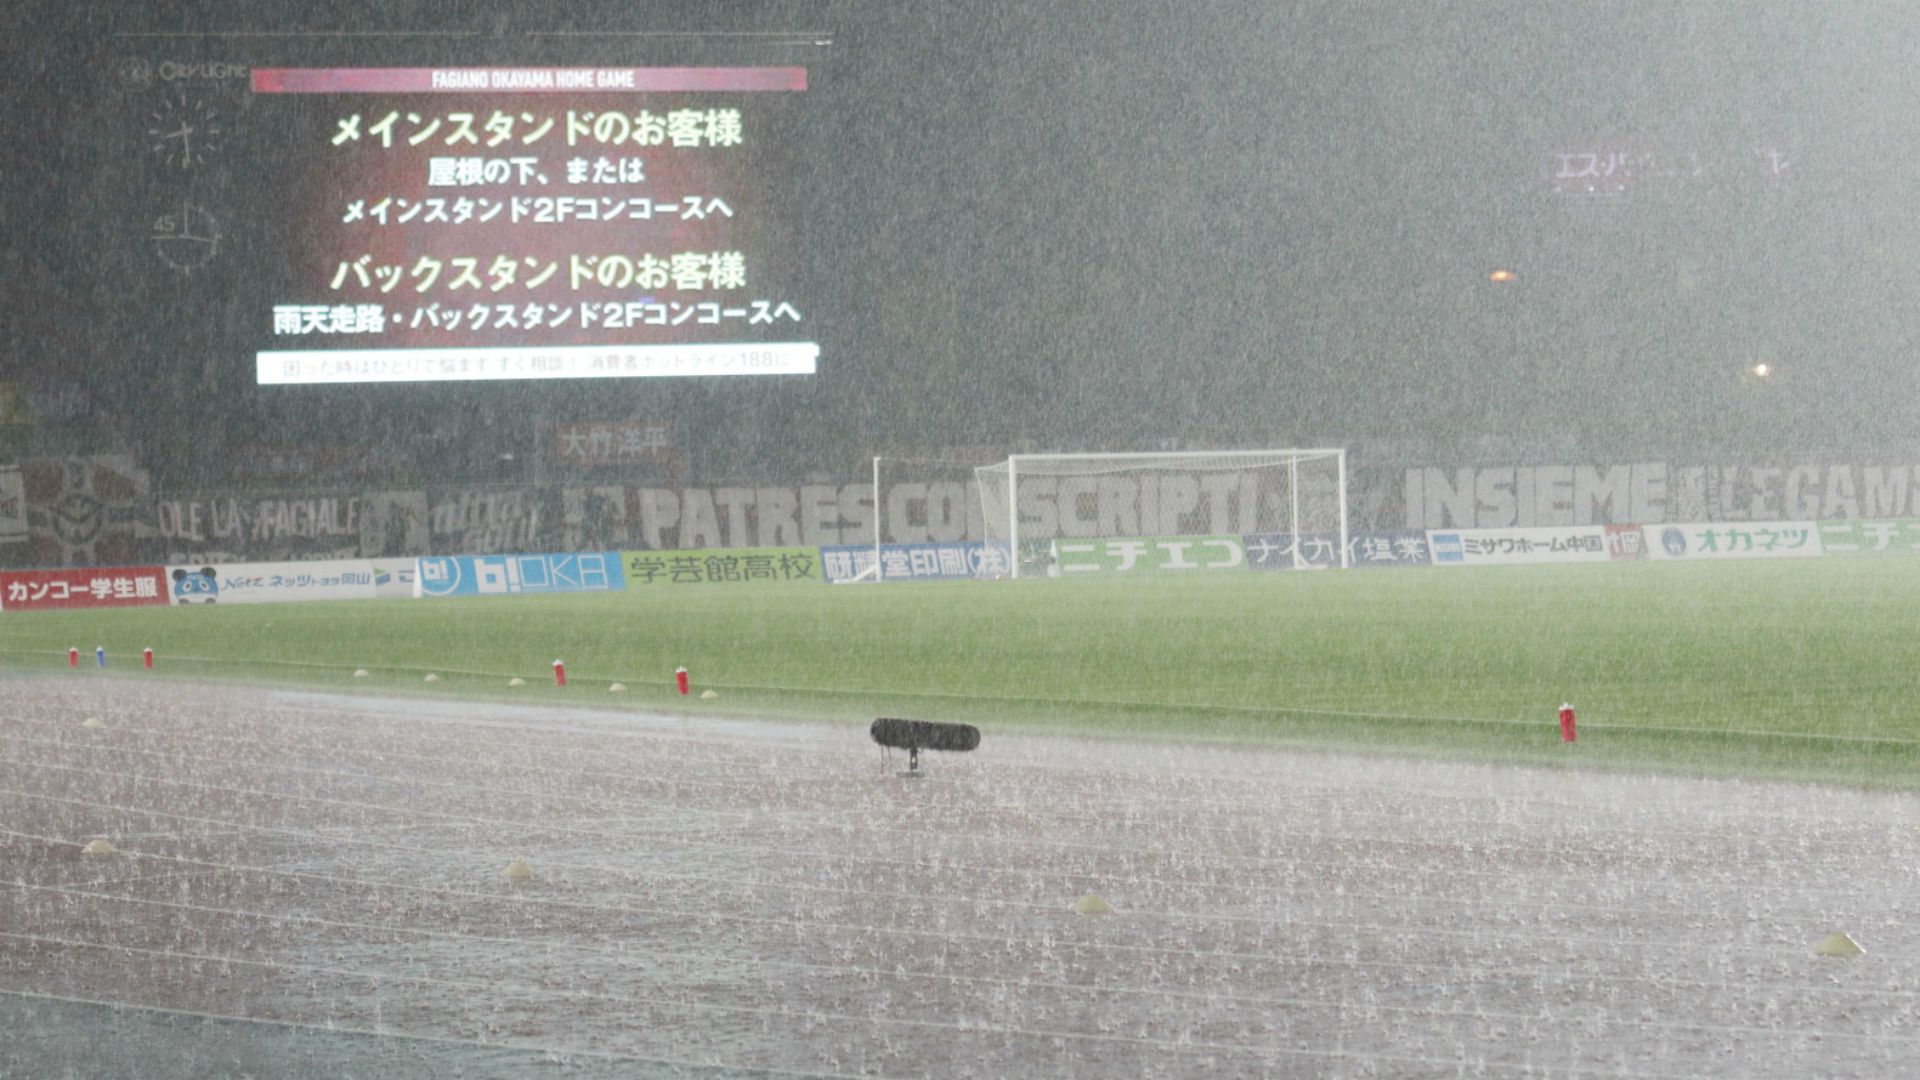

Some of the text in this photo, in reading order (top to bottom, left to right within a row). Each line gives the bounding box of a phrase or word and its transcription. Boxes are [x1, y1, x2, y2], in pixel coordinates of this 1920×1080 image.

[431, 69, 635, 89] FAGIANO OKAYAMA HOME GAME
[331, 107, 743, 148] メインスタンドのお客様
[428, 156, 645, 187] 屋根の下、または
[343, 195, 734, 224] メインスタンド2Fコンコースへ
[330, 251, 746, 293] バックスタンドのお客様
[561, 425, 668, 459] 大竹洋平
[1405, 461, 1668, 529] INSIEME
[1720, 462, 1920, 524] LEGAM
[639, 482, 876, 550] PATRES
[1061, 539, 1244, 572] ニチエコ
[1463, 534, 1604, 555] ミサワホーム中国
[1695, 528, 1809, 553] オカネツ
[631, 552, 816, 585] 学芸館高校
[8, 576, 158, 602] カンコー学生服
